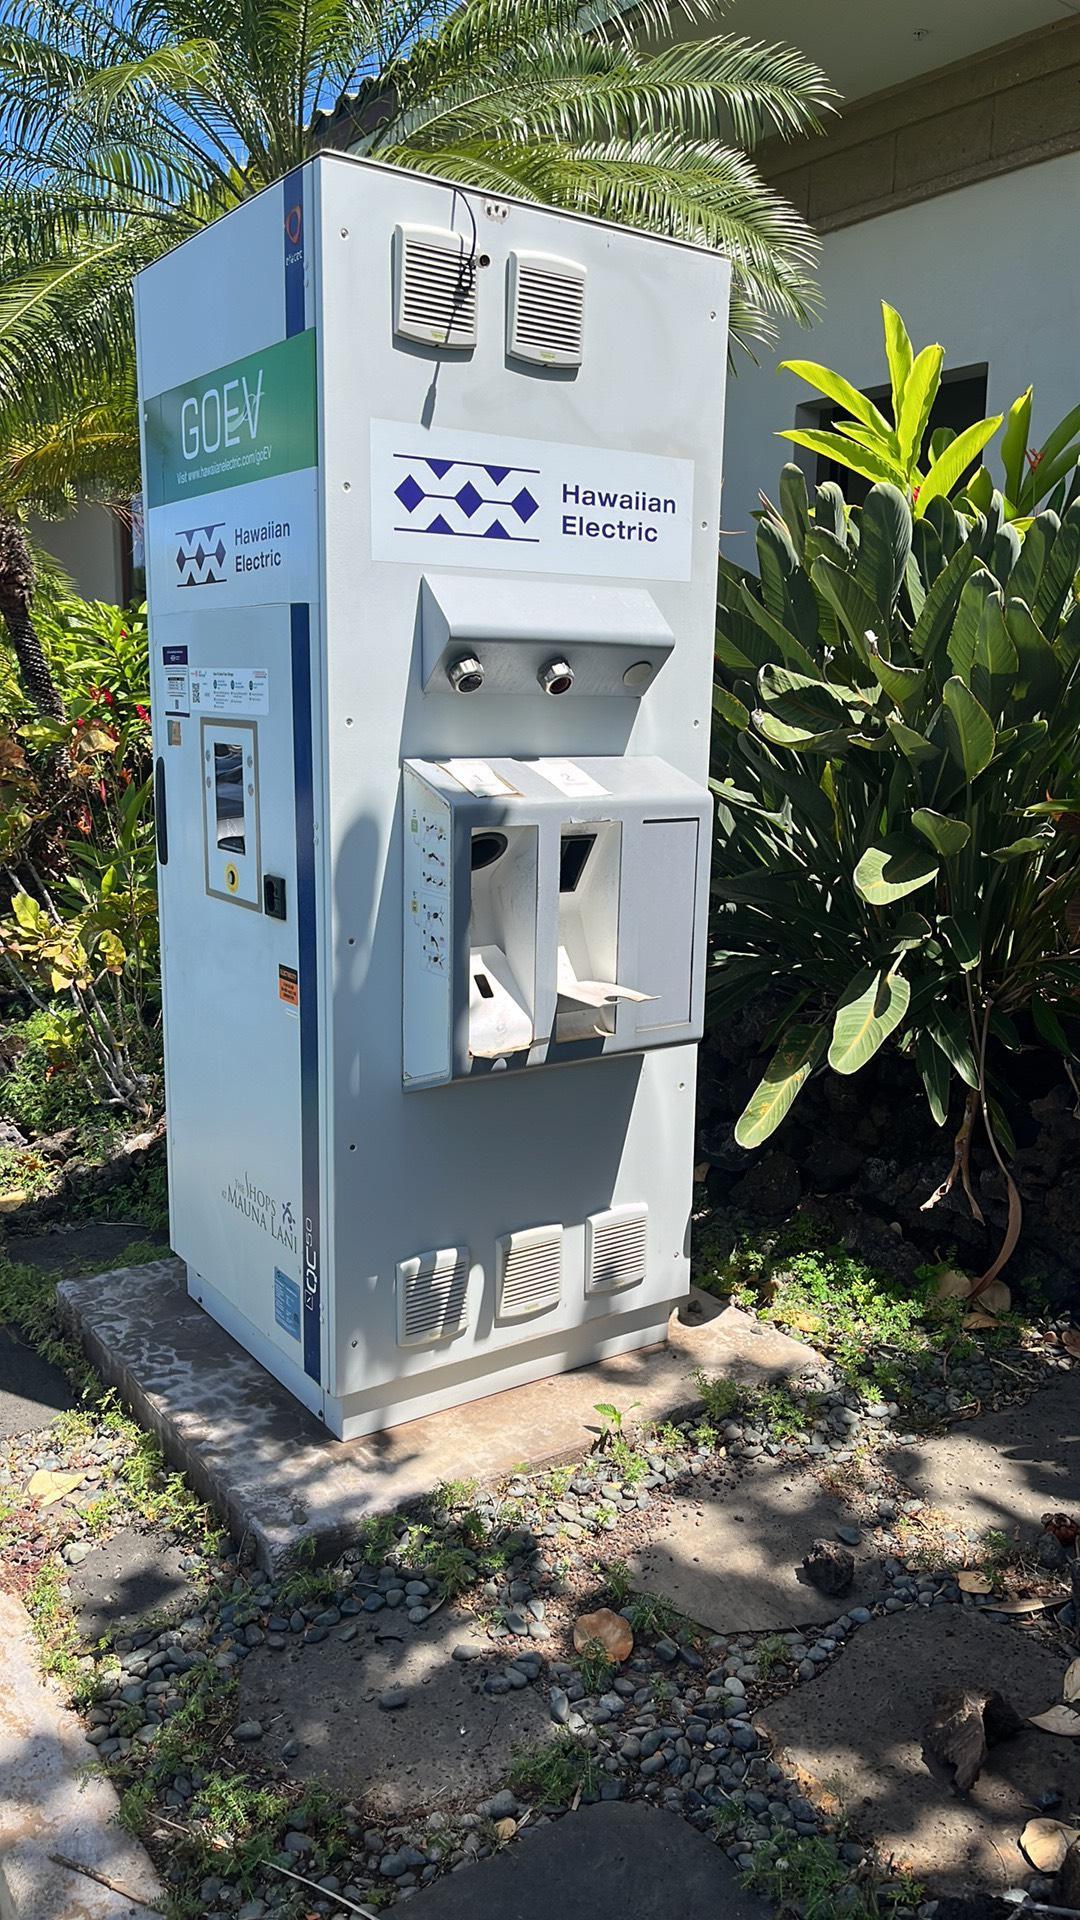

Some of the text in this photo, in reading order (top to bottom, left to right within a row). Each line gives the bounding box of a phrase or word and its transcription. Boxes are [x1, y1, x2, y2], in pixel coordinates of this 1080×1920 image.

[562, 483, 676, 514] Hawaiian
[234, 521, 290, 546] Hawaiian
[562, 515, 658, 543] Electric
[235, 549, 281, 573] Electric
[245, 1171, 276, 1217] SHOPS
[228, 1184, 267, 1232] MAUNA
[270, 1215, 297, 1254] LANI
